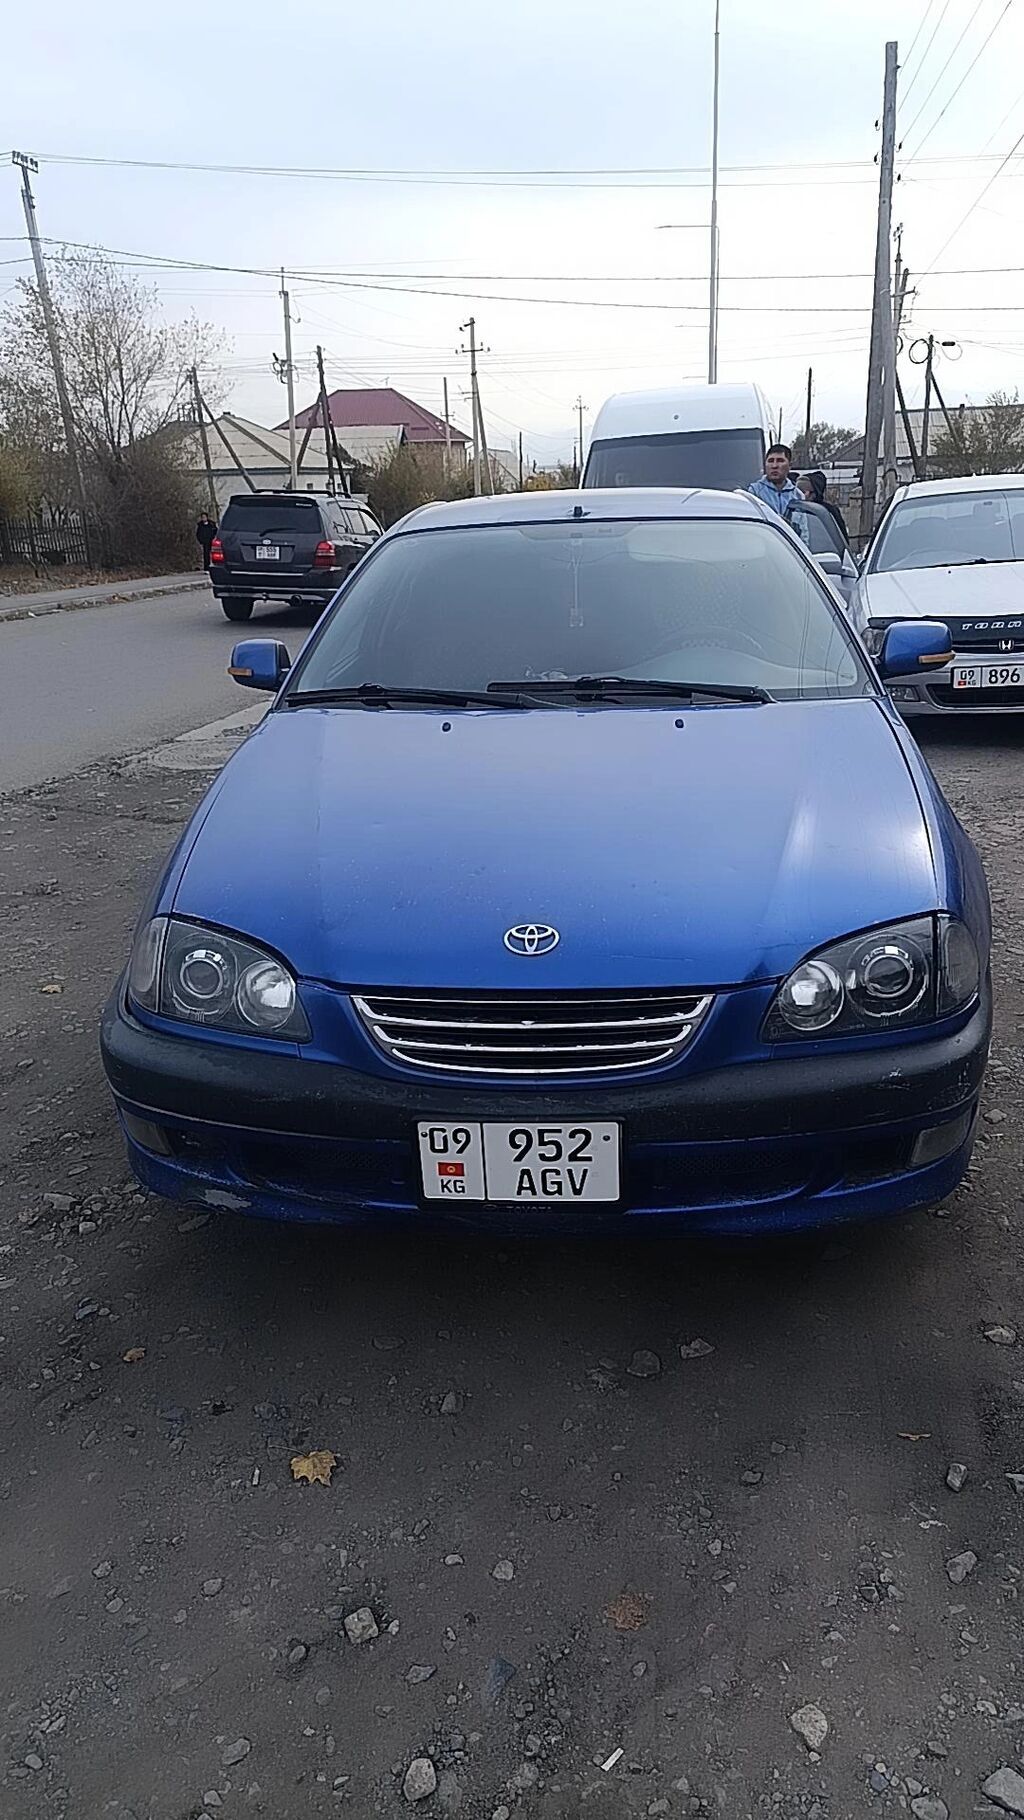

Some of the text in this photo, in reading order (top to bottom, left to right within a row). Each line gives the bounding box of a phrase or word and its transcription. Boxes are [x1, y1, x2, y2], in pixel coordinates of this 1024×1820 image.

[960, 668, 1020, 684] 09 896
[428, 1127, 593, 1162] 09 952
[440, 1179, 466, 1193] KG
[516, 1168, 589, 1196] AGV
